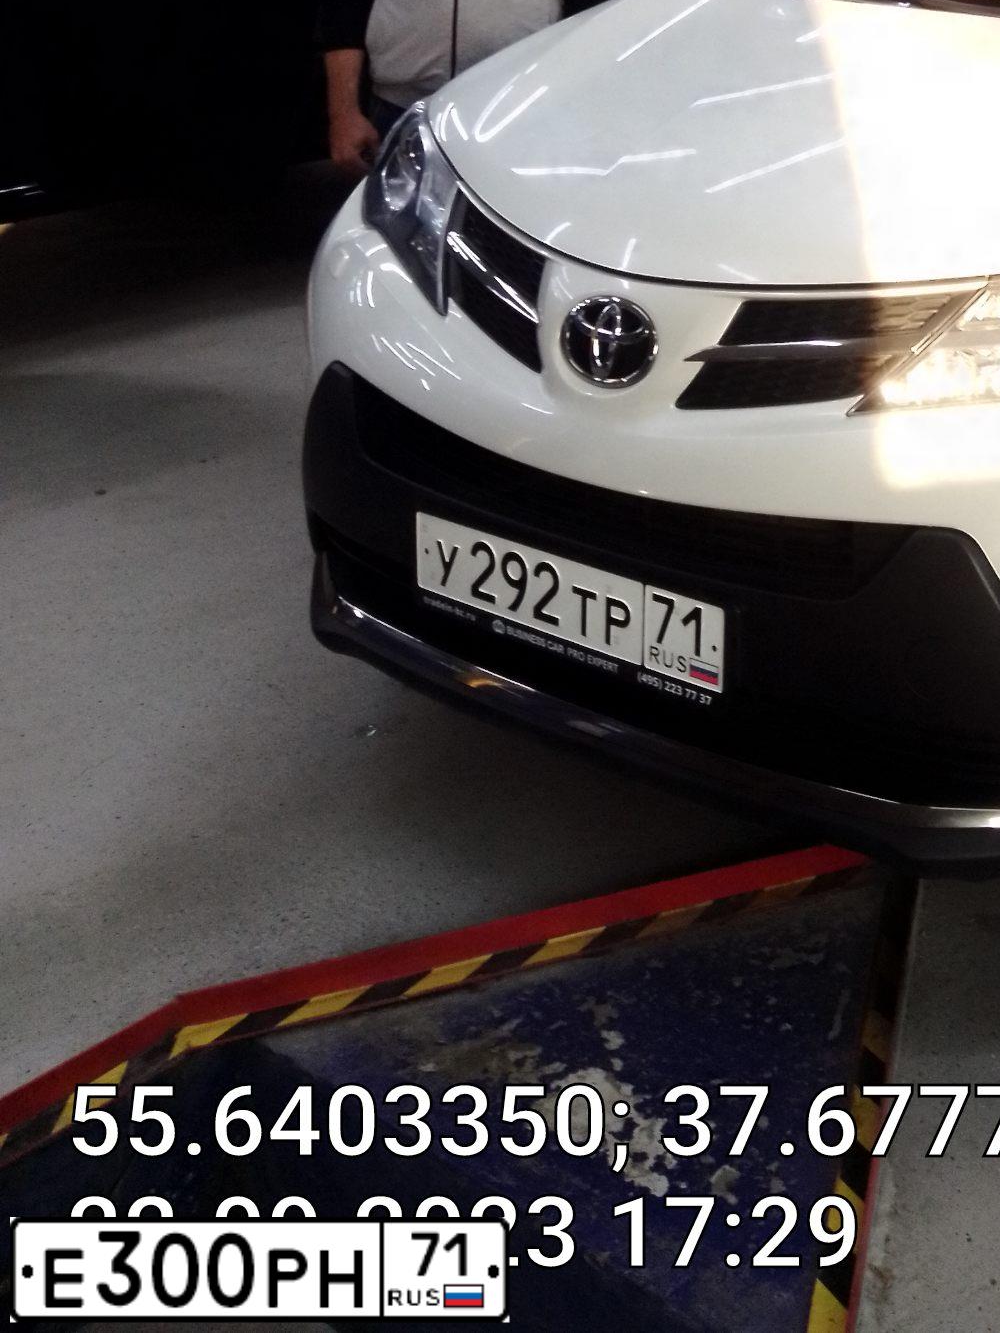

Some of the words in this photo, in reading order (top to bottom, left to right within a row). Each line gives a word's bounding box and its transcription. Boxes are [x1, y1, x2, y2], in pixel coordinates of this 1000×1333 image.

[652, 592, 703, 657] 71
[506, 625, 547, 648] BUSINESS
[547, 640, 566, 655] CAR
[567, 646, 586, 663] PRO
[586, 654, 620, 674] EXPERT
[649, 645, 688, 673] RUS
[637, 671, 663, 690] (495)
[664, 681, 683, 696] 223
[684, 688, 697, 700] 77
[699, 693, 712, 705] 37
